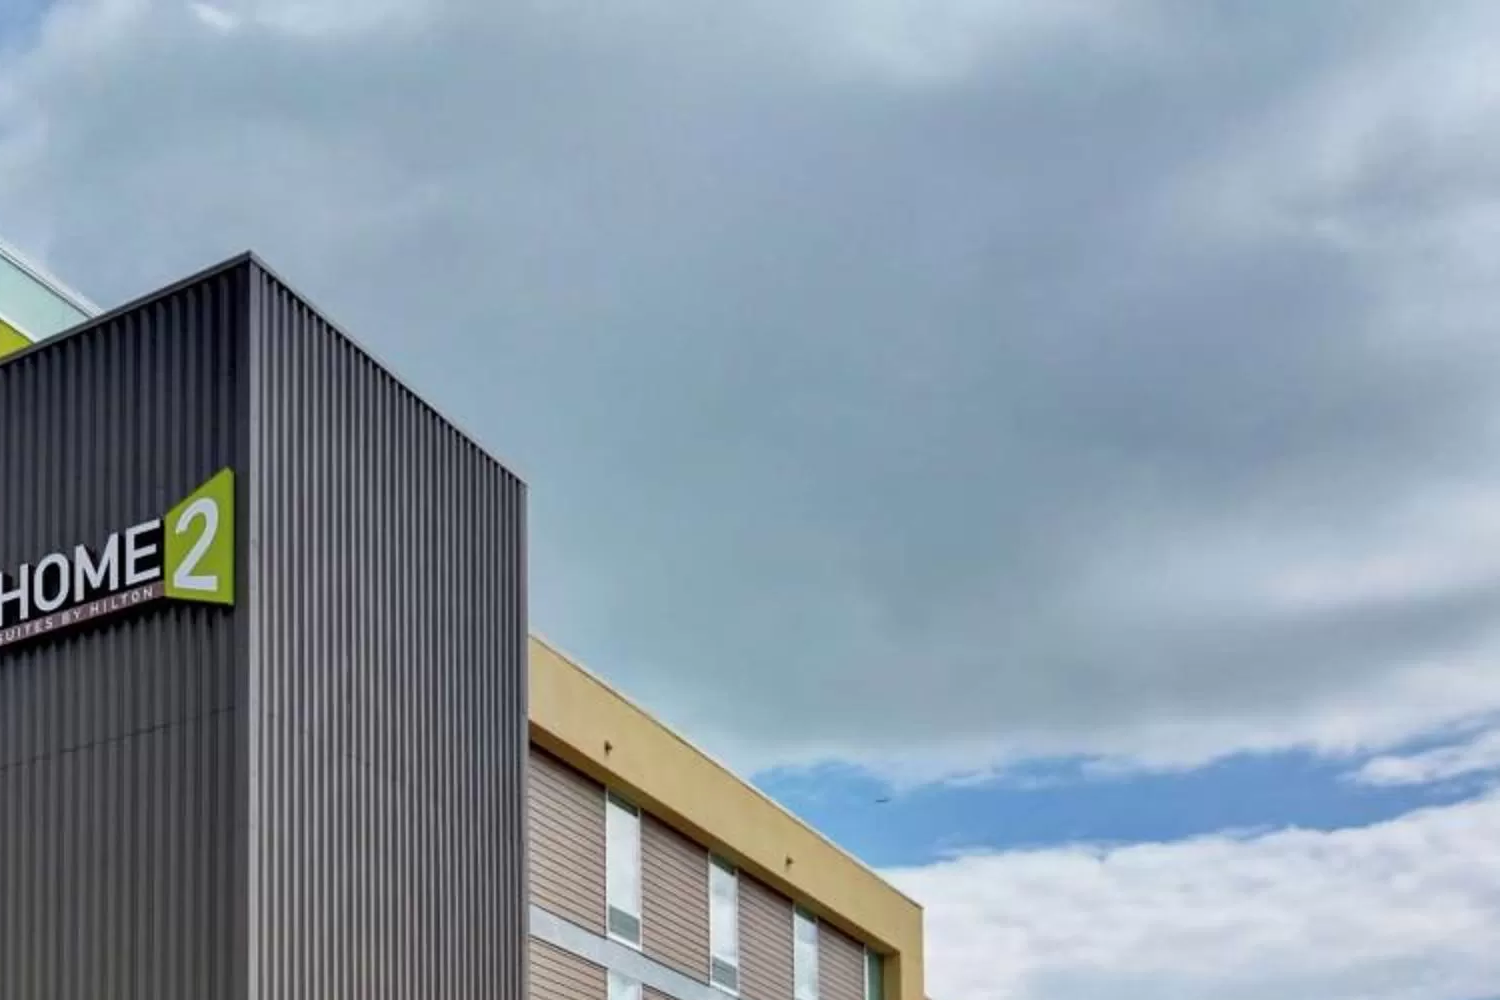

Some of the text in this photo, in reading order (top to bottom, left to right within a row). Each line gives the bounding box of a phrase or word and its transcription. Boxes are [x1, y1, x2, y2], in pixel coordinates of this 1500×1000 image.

[174, 497, 218, 592] 2
[61, 608, 82, 624] BY
[90, 586, 154, 615] HILTON
